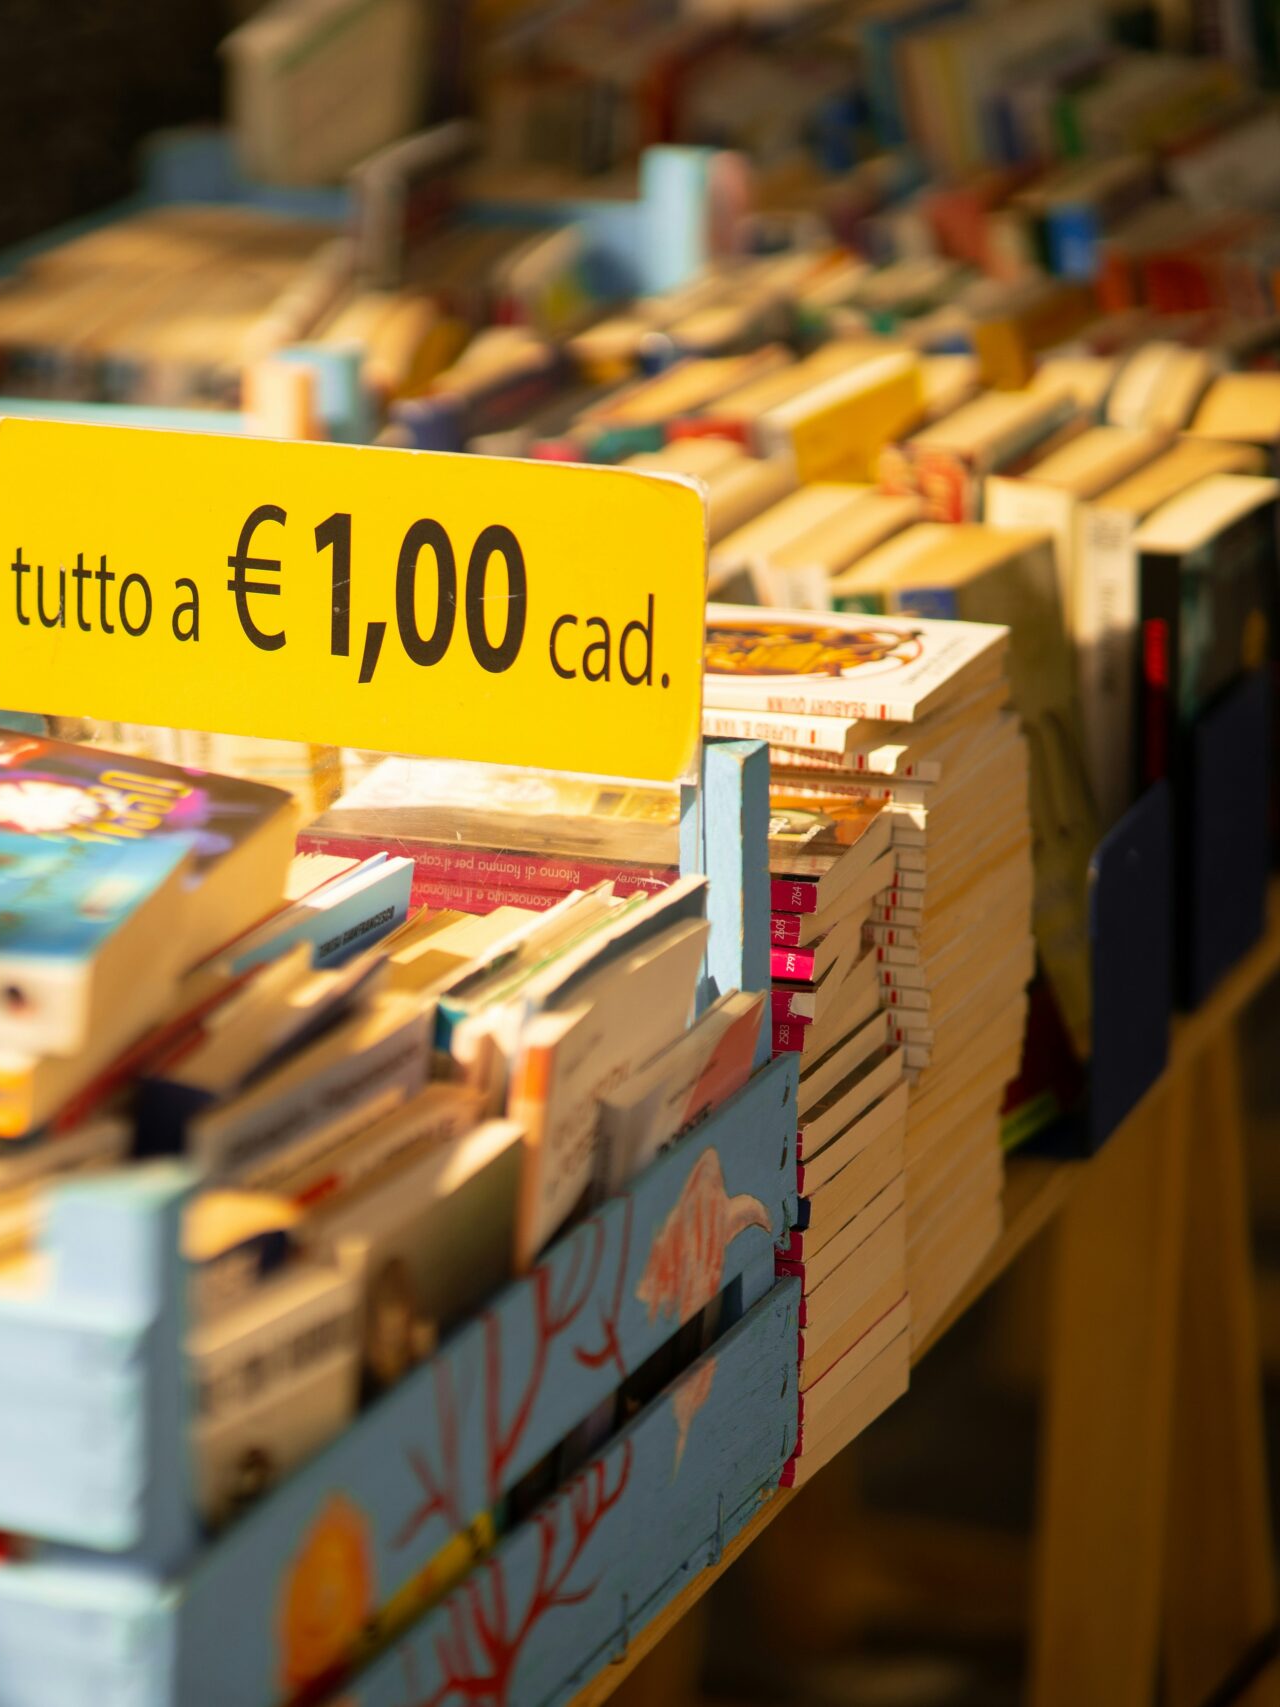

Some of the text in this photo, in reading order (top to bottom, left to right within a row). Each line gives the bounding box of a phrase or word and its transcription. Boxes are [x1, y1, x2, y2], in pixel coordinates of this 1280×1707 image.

[10, 504, 671, 690] tutto a € 1,00 cad.
[455, 857, 475, 870] per
[478, 861, 521, 880] fiamma
[525, 865, 537, 878] di
[540, 866, 581, 884] Ritorno
[463, 889, 473, 904] il
[791, 886, 802, 907] 2764
[775, 919, 786, 940] 2605
[786, 952, 796, 973] 2791
